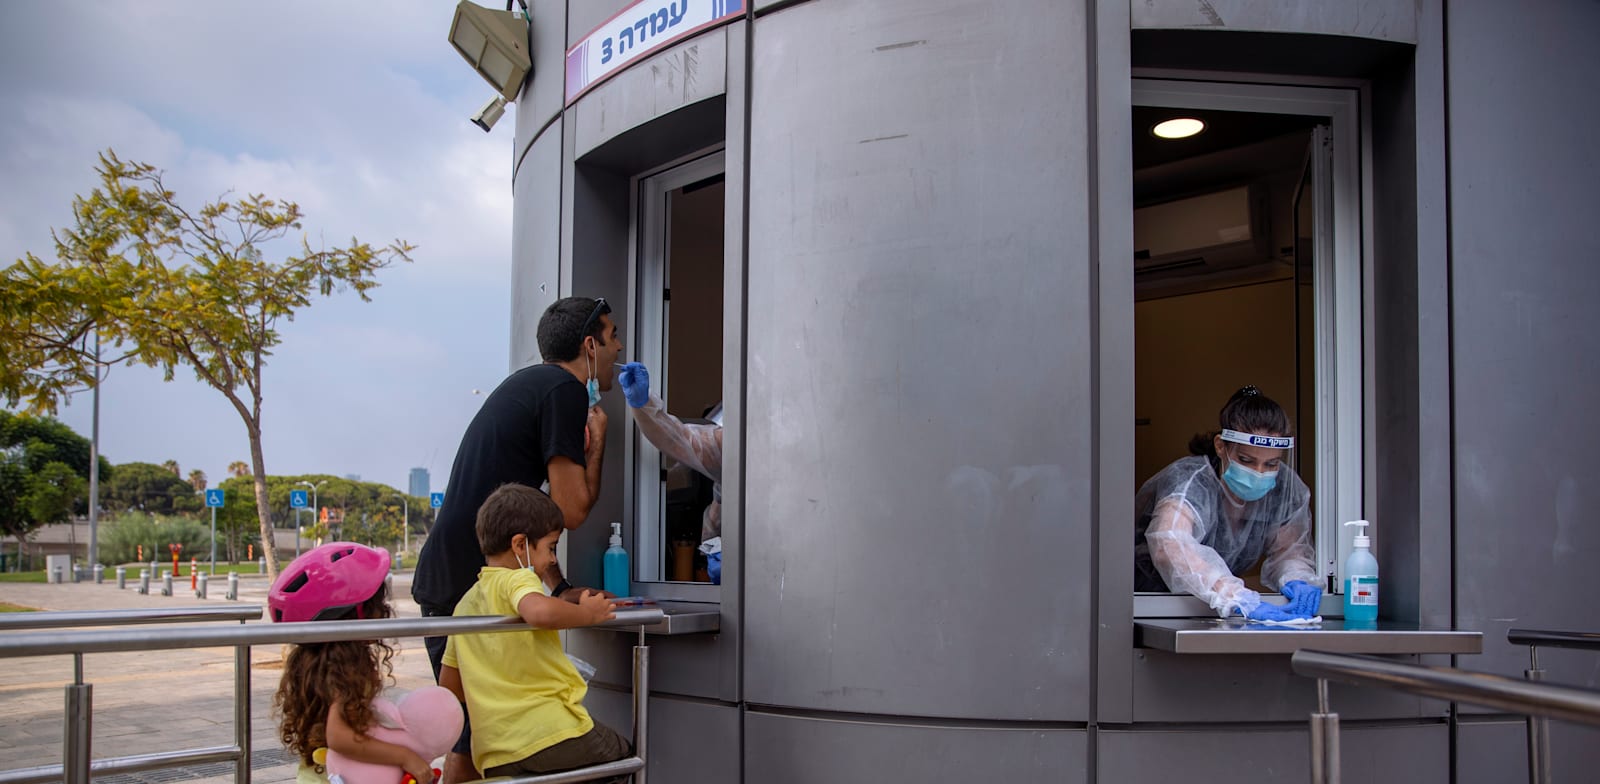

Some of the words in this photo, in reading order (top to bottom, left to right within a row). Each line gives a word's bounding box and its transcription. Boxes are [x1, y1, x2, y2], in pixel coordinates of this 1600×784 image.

[619, 0, 688, 54] עמדה
[601, 37, 613, 64] 3
[1254, 437, 1267, 445] מגן
[1268, 438, 1289, 447] משקף
